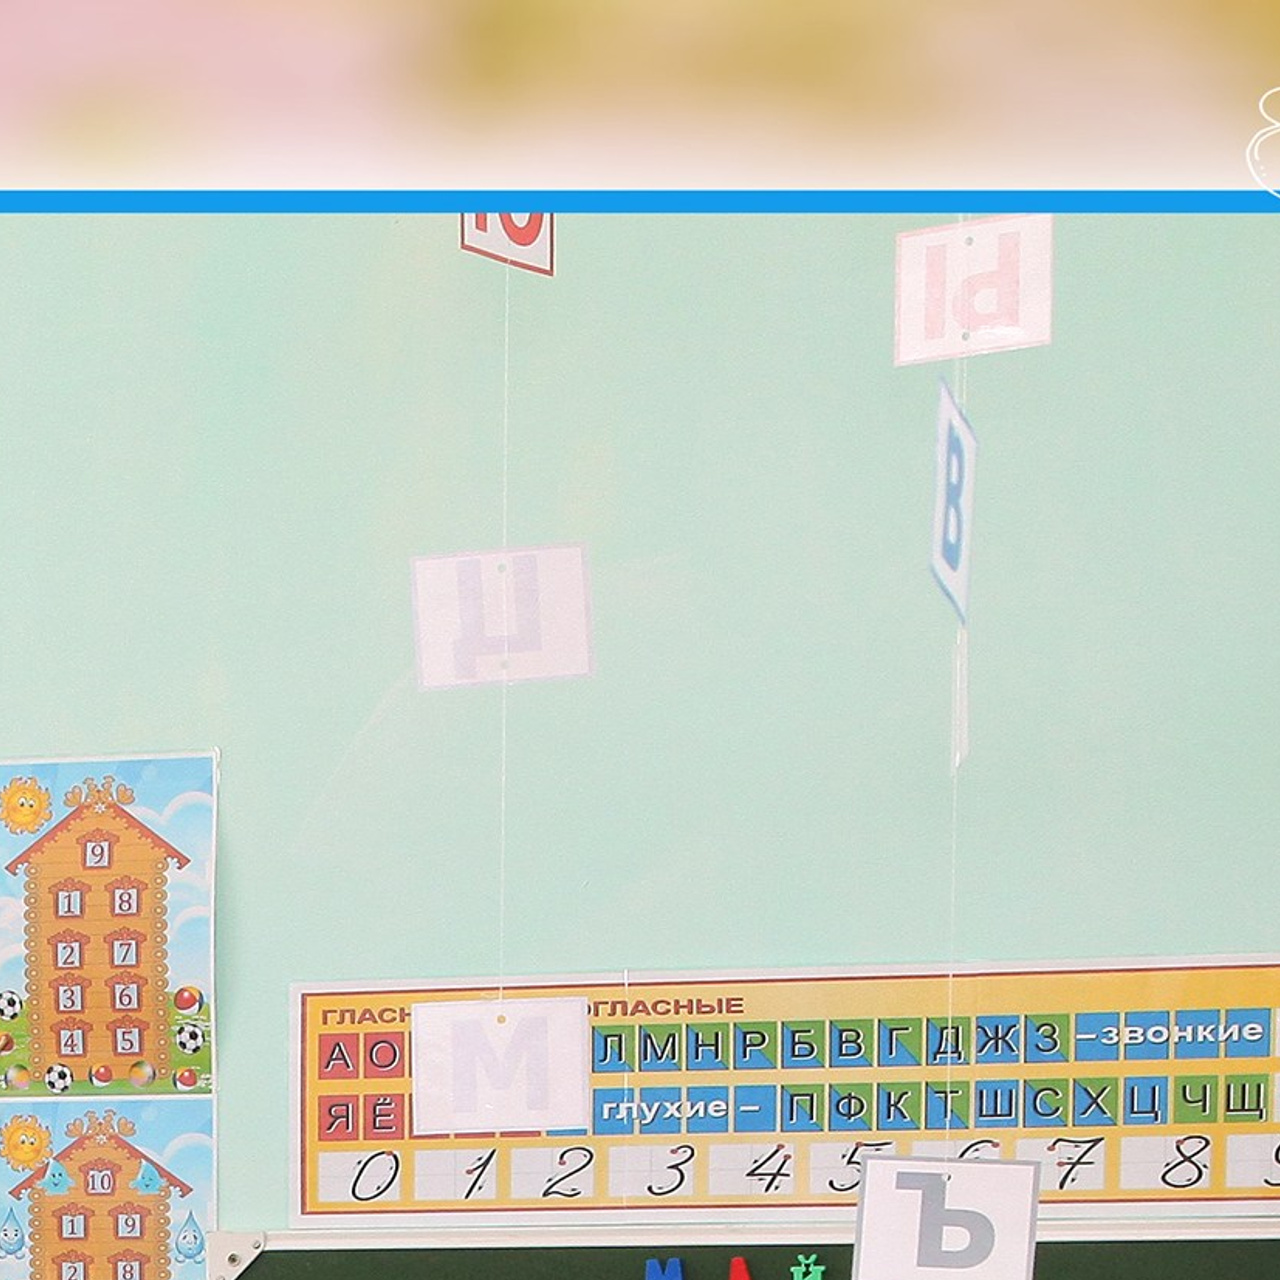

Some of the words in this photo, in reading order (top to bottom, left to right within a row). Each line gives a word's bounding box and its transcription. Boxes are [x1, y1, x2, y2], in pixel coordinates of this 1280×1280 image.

[91, 843, 105, 865] 9
[63, 893, 75, 915] 1
[118, 891, 132, 913] 8
[62, 944, 75, 966] 2
[119, 942, 133, 963] 7
[63, 987, 77, 1009] 3
[118, 986, 132, 1008] 6
[586, 997, 745, 1018] ГЛАСНЫЕ
[63, 1032, 78, 1053] 4
[121, 1029, 134, 1051] 5
[324, 1041, 355, 1072] А
[370, 1040, 400, 1069] О
[601, 1033, 626, 1064] Л
[643, 1033, 677, 1064] М
[694, 1031, 722, 1063] Н
[742, 1030, 768, 1061] Р
[790, 1028, 817, 1060] Б
[837, 1027, 865, 1059] В
[887, 1026, 912, 1057] Г
[932, 1025, 965, 1063] Д
[976, 1023, 1020, 1055] Ж
[1034, 1022, 1061, 1053] З
[327, 1103, 354, 1132] Я
[373, 1096, 396, 1132] Ё
[601, 1098, 728, 1123] глухие
[788, 1092, 816, 1124] П
[835, 1090, 868, 1121] Ф
[885, 1089, 911, 1121] К
[933, 1088, 963, 1120] Т
[977, 1087, 1015, 1119] Ш
[1033, 1086, 1063, 1118] С
[1078, 1084, 1112, 1117] Х
[1129, 1084, 1161, 1124] Ц
[1181, 1083, 1210, 1115] Ч
[1224, 1082, 1267, 1122] Щ
[351, 1150, 400, 1202] 0
[464, 1148, 497, 1199] 1
[542, 1146, 594, 1198] 2
[647, 1144, 695, 1197] 3
[745, 1144, 791, 1194] 4
[1051, 1136, 1105, 1190] 7
[1160, 1134, 1211, 1188] 8
[89, 1173, 112, 1191] 10
[68, 1218, 77, 1236] 1
[123, 1214, 137, 1236] 9
[896, 1171, 995, 1269] Ъ
